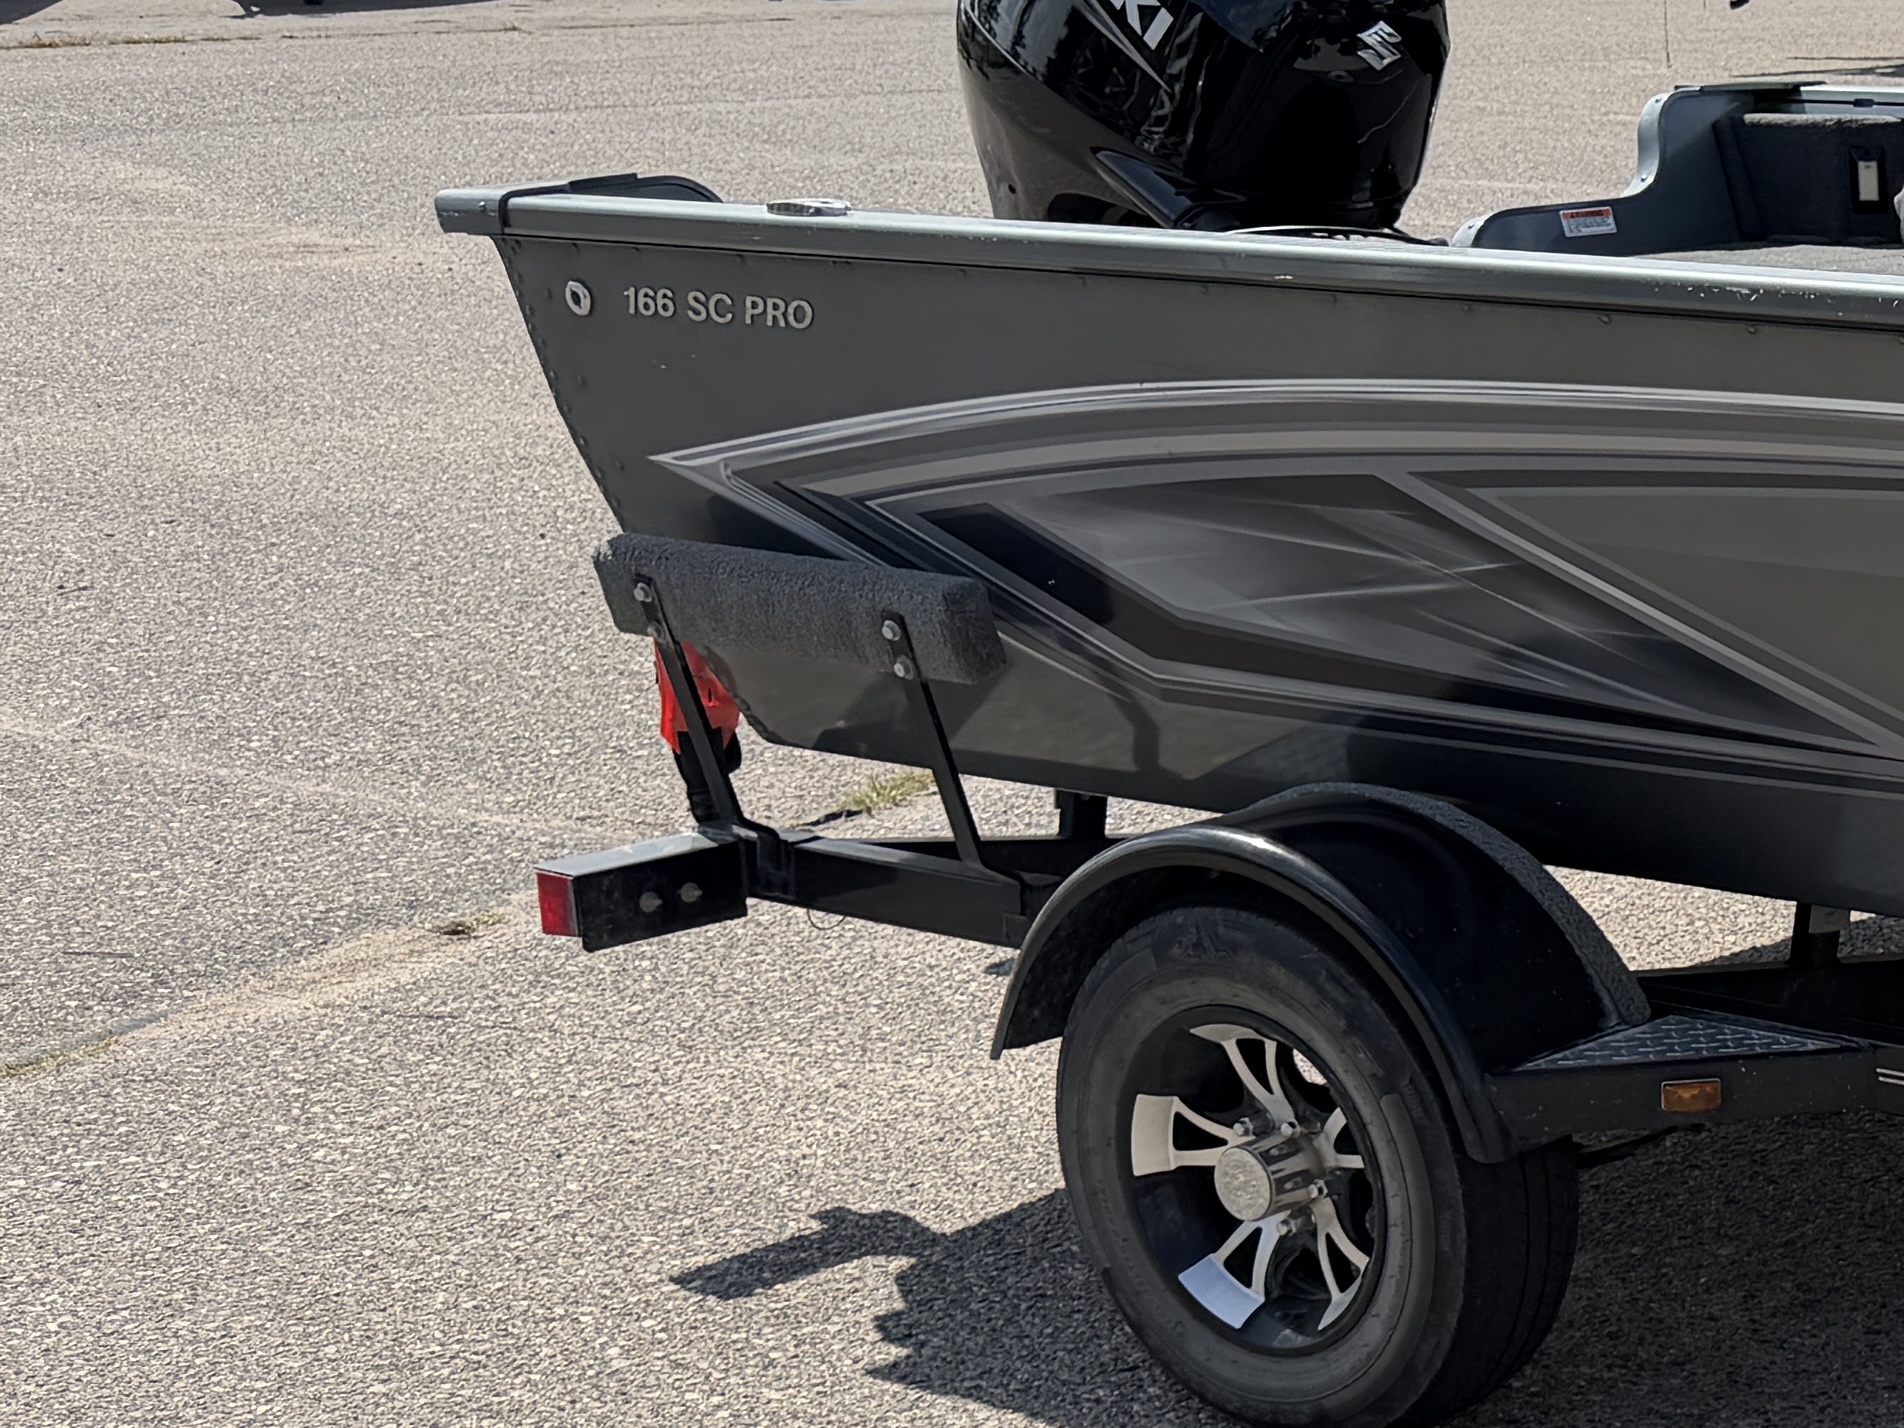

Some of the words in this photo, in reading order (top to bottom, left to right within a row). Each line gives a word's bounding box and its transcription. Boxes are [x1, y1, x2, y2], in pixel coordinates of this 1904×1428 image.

[623, 286, 676, 318] 166
[686, 290, 734, 324] SC
[744, 295, 814, 329] PRO
